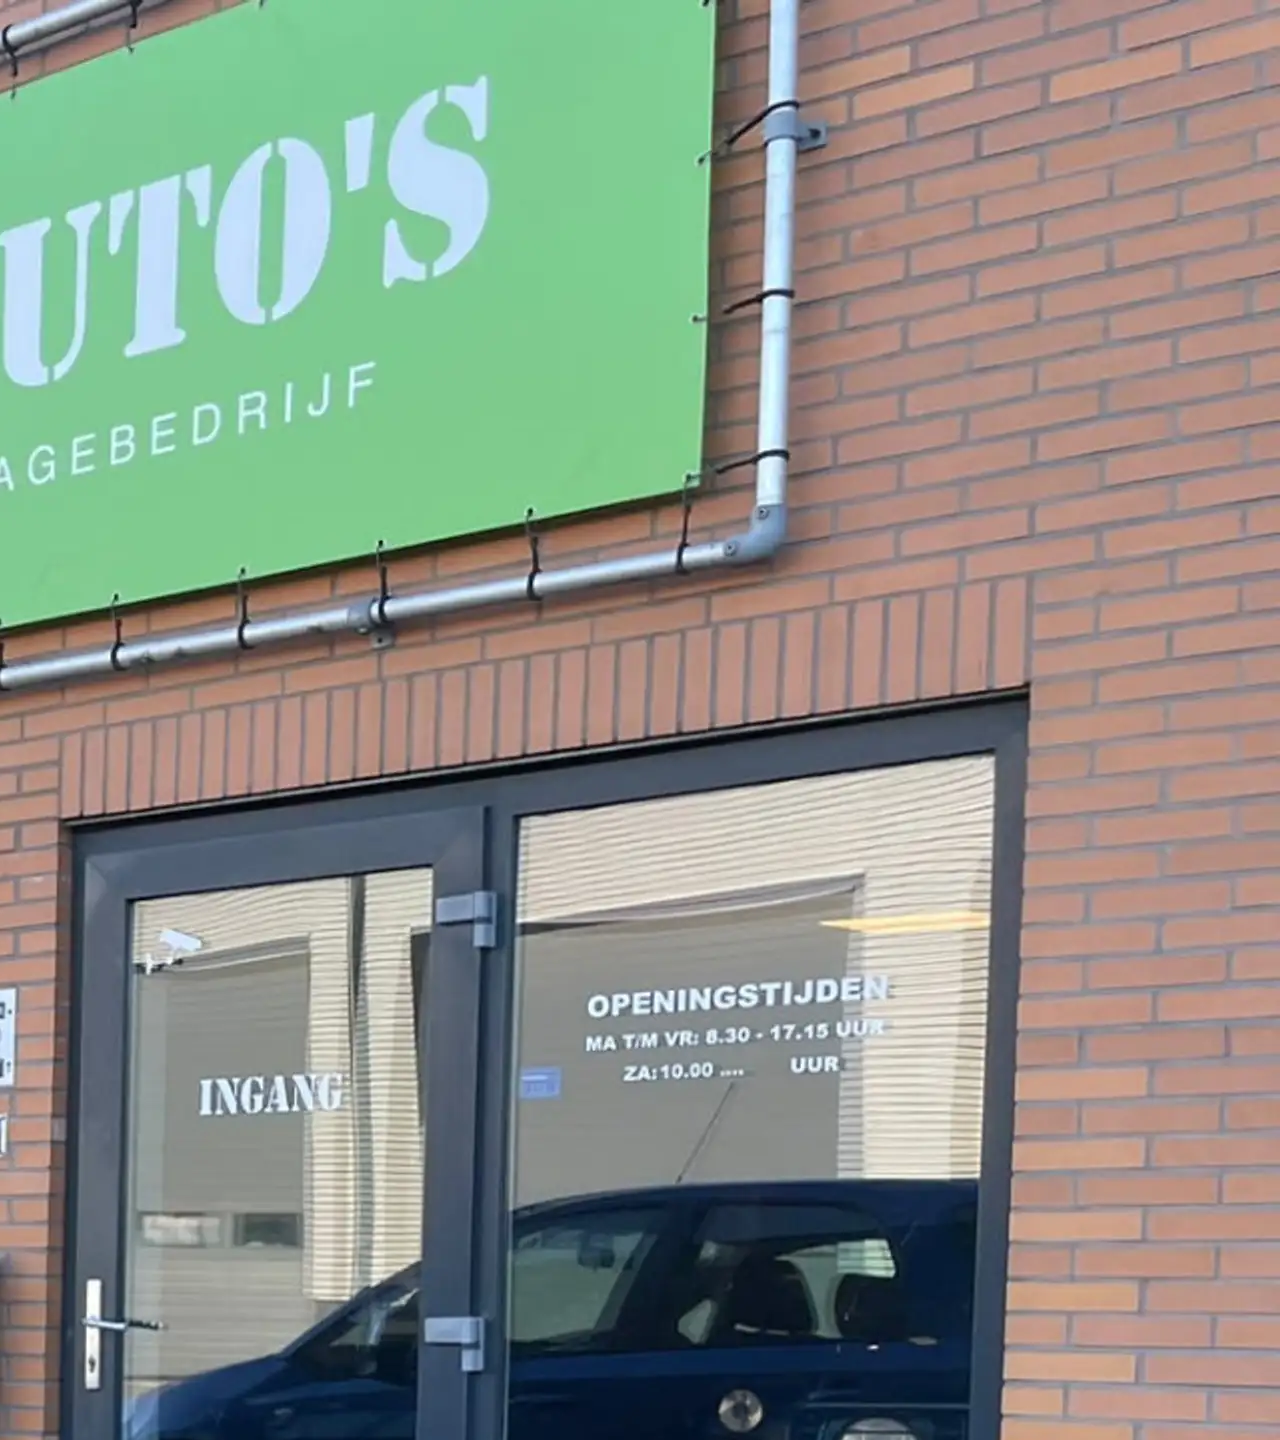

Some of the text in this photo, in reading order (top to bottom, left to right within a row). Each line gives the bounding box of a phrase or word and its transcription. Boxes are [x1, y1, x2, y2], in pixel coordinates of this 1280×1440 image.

[587, 974, 890, 1018] OPENINGSTIJDEN
[585, 1036, 617, 1052] MA
[623, 1032, 658, 1049] T/M
[664, 1030, 699, 1047] VR:
[705, 1026, 750, 1045] 8.30
[770, 1023, 829, 1042] 17.15
[836, 1018, 886, 1037] UUR
[790, 1056, 839, 1074] UUR
[199, 1072, 343, 1116] INGANG
